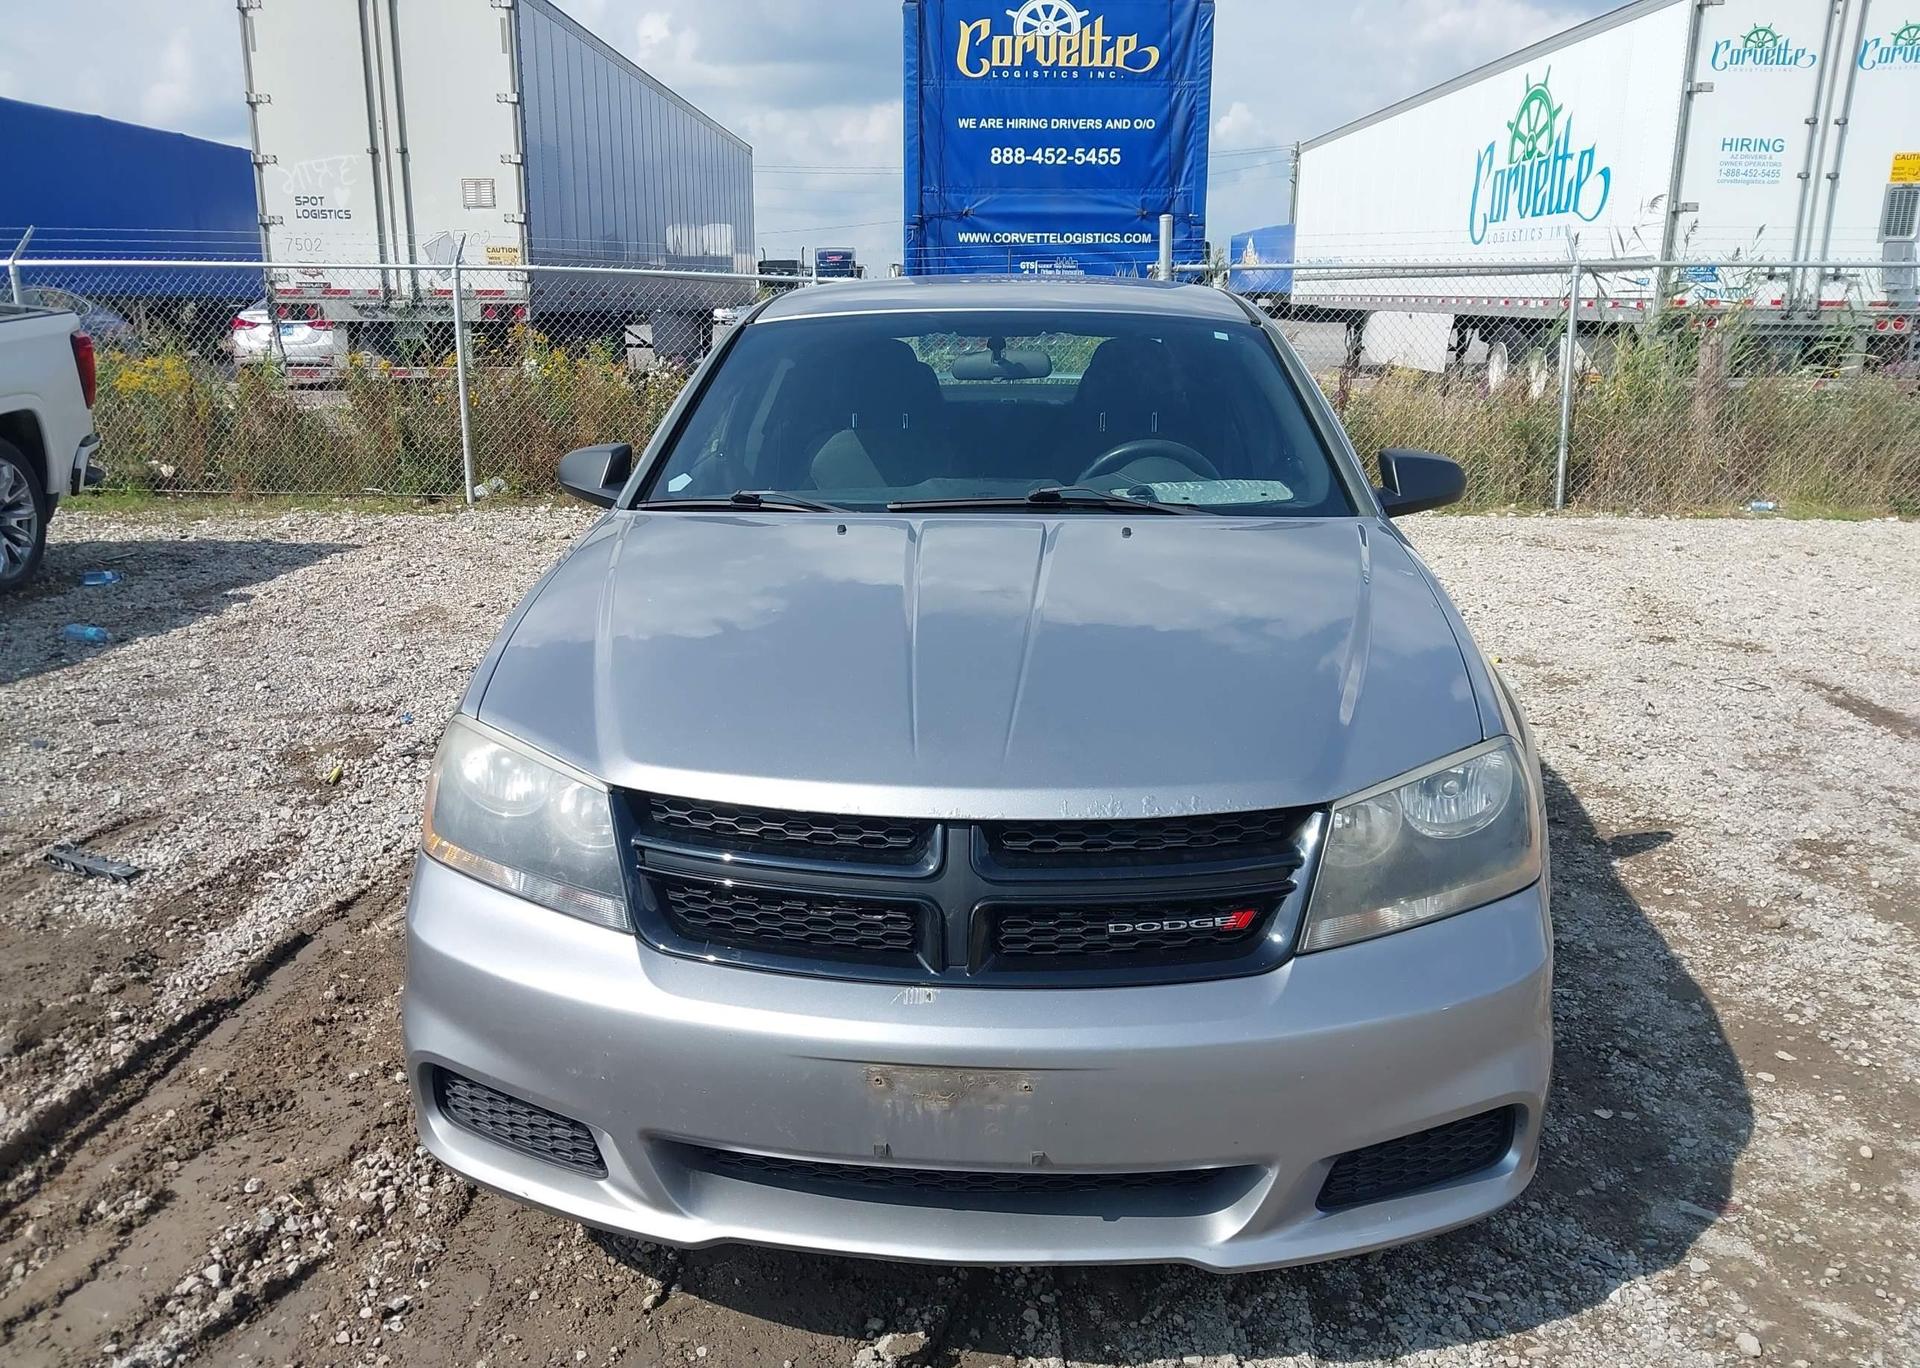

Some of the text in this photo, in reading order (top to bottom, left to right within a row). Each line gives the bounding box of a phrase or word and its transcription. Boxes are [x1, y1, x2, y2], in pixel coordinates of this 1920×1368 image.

[957, 15, 1160, 78] Corvette
[1711, 38, 1817, 72] Corvette
[992, 70, 1125, 79] LOGISTICS INC.
[958, 118, 1156, 130] WE ARE HIRING DRIVERS AND O/O
[1721, 137, 1785, 153] HIRING
[990, 147, 1121, 165] 888-452-5455
[1895, 153, 1920, 161] CAUTI
[1470, 111, 1611, 245] Corvette
[1719, 168, 1782, 178] 1-888-452-5455
[295, 196, 325, 206] SPOT
[295, 209, 351, 219] LOGISTICS
[958, 232, 1152, 244] WWW.CORVETTELOGISTICS.COM
[1487, 227, 1543, 244] LOGISTICS
[285, 237, 324, 252] 7502
[1020, 261, 1035, 270] GTS
[1108, 915, 1237, 934] DODGE
